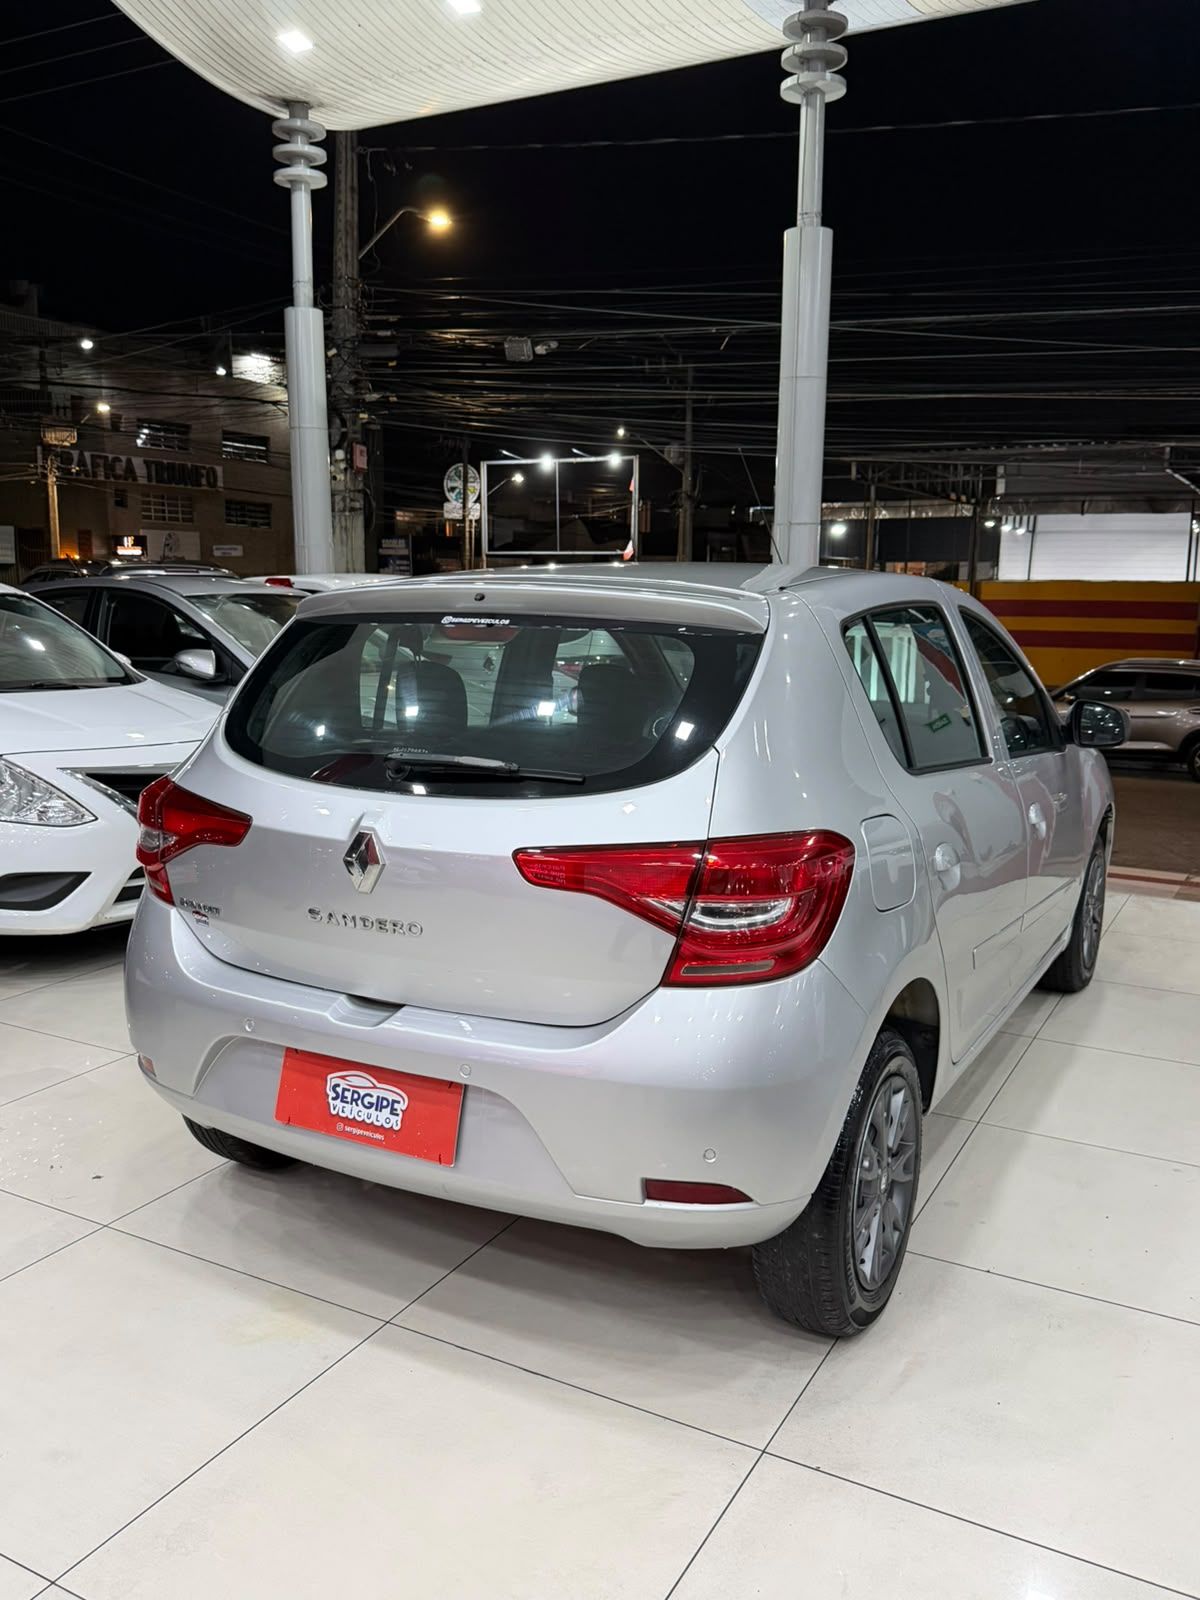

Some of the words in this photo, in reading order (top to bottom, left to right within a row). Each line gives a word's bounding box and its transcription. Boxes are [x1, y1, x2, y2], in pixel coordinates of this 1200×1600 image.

[143, 458, 218, 489] TRIUNFO
[307, 907, 424, 936] SANDERO
[330, 1082, 402, 1117] SERGIPE
